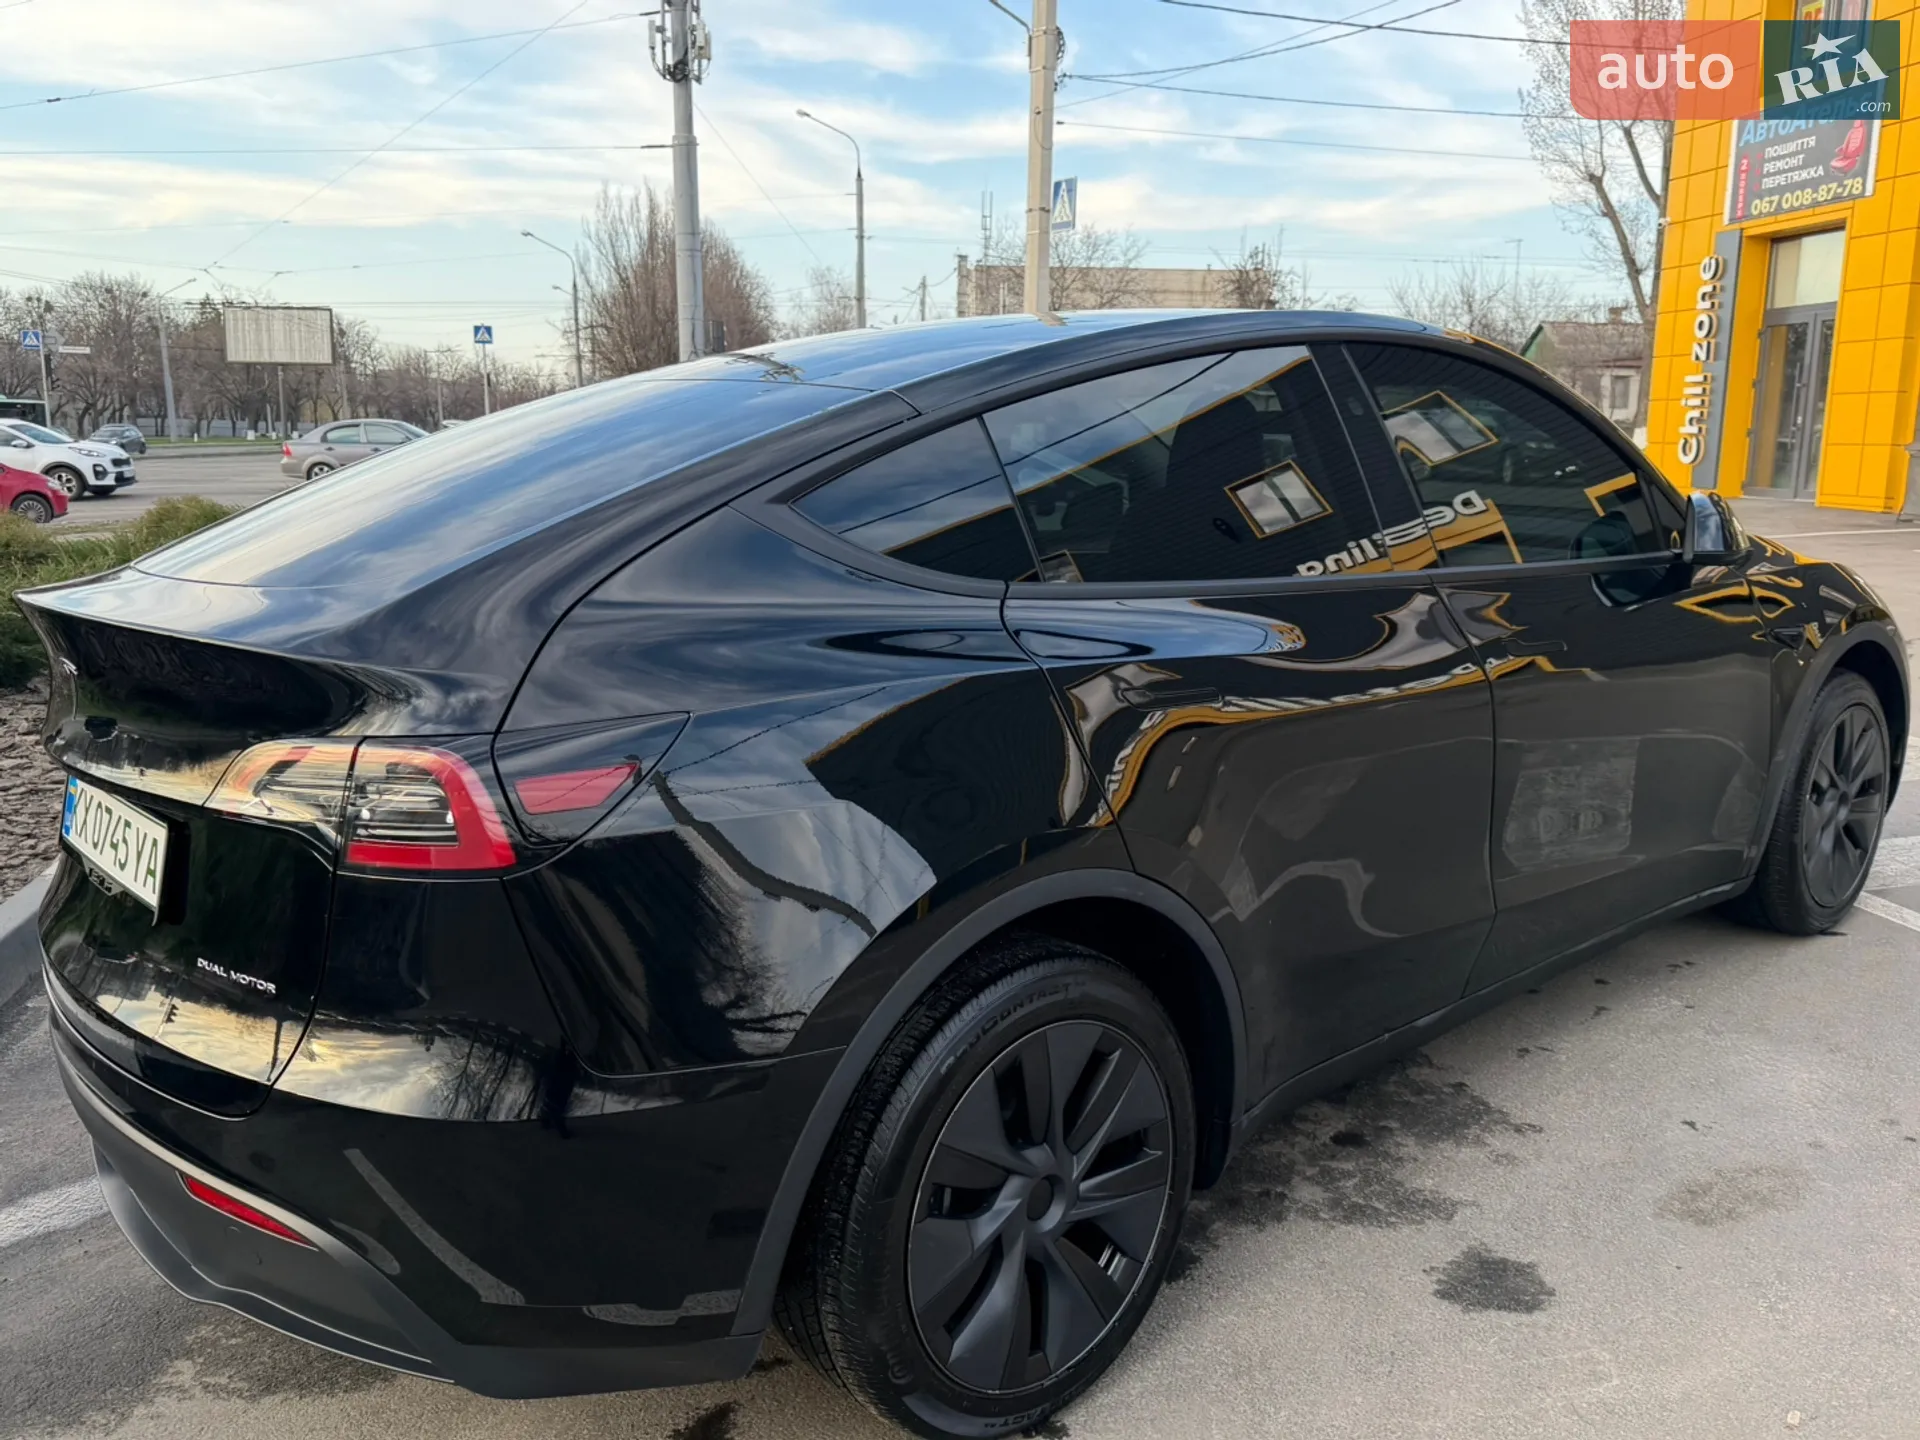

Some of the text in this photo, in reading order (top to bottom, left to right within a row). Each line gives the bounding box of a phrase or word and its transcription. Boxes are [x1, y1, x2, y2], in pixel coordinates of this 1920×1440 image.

[1764, 136, 1816, 159] ПОШИТТЯ
[1761, 165, 1825, 190] ПЕРЕТЯЖКА
[1762, 154, 1805, 175] РЕМОНТ
[1750, 177, 1864, 216] 067 008-87-78
[1691, 254, 1724, 363] zone
[197, 957, 277, 995] DUAL MOTOR
